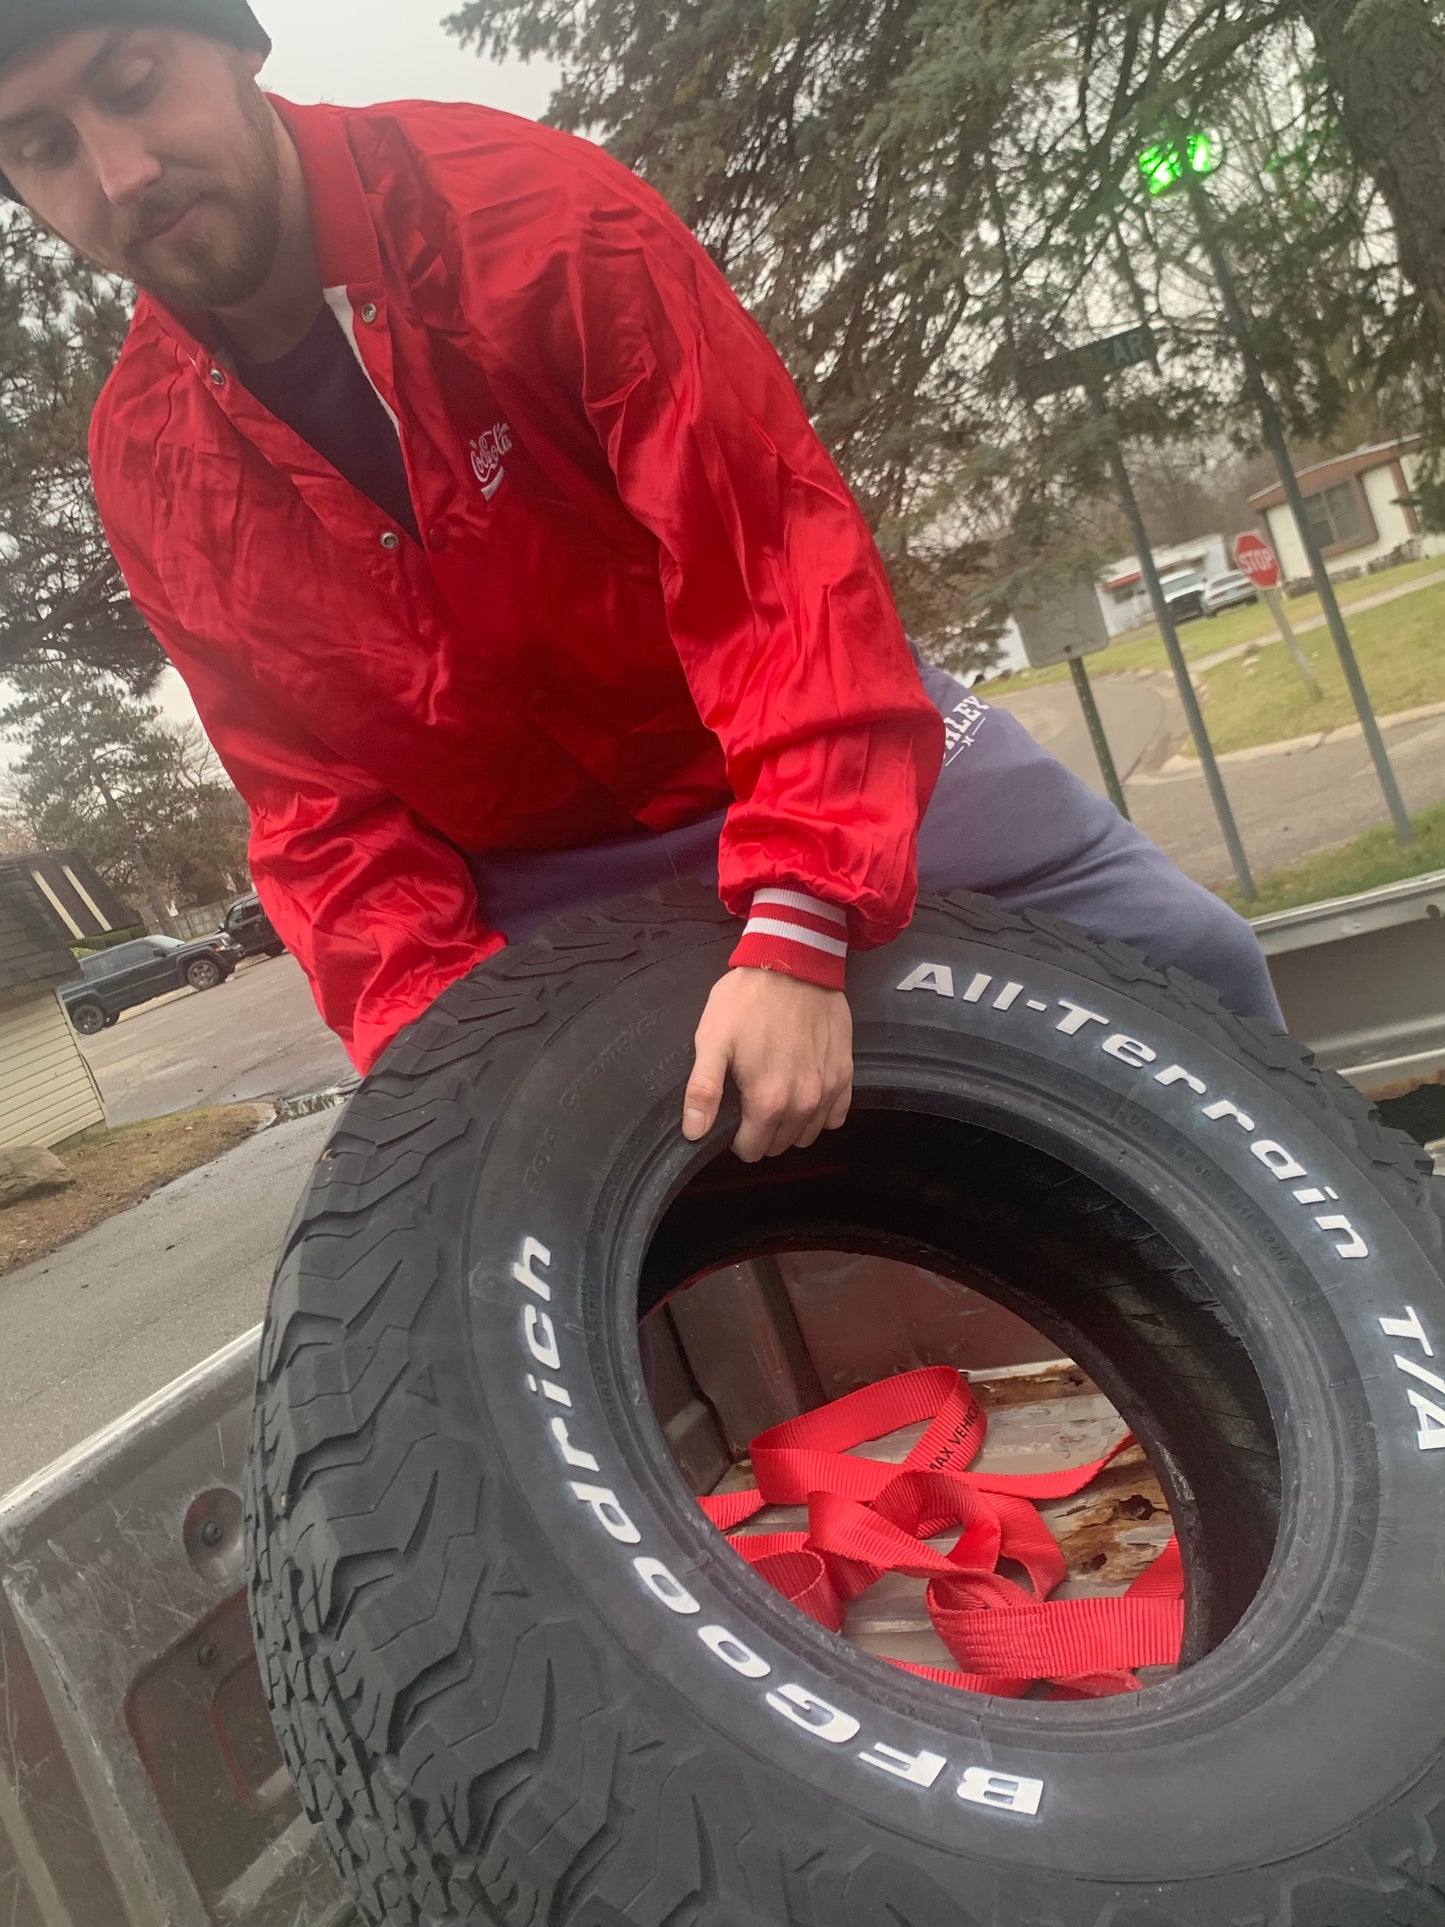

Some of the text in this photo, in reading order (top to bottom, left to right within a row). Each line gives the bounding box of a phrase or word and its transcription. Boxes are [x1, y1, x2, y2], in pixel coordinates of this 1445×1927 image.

[1239, 549, 1272, 574] STOP
[897, 962, 1445, 1450] All-Terrain T/A
[512, 1236, 1044, 1815] BFGoodrich
